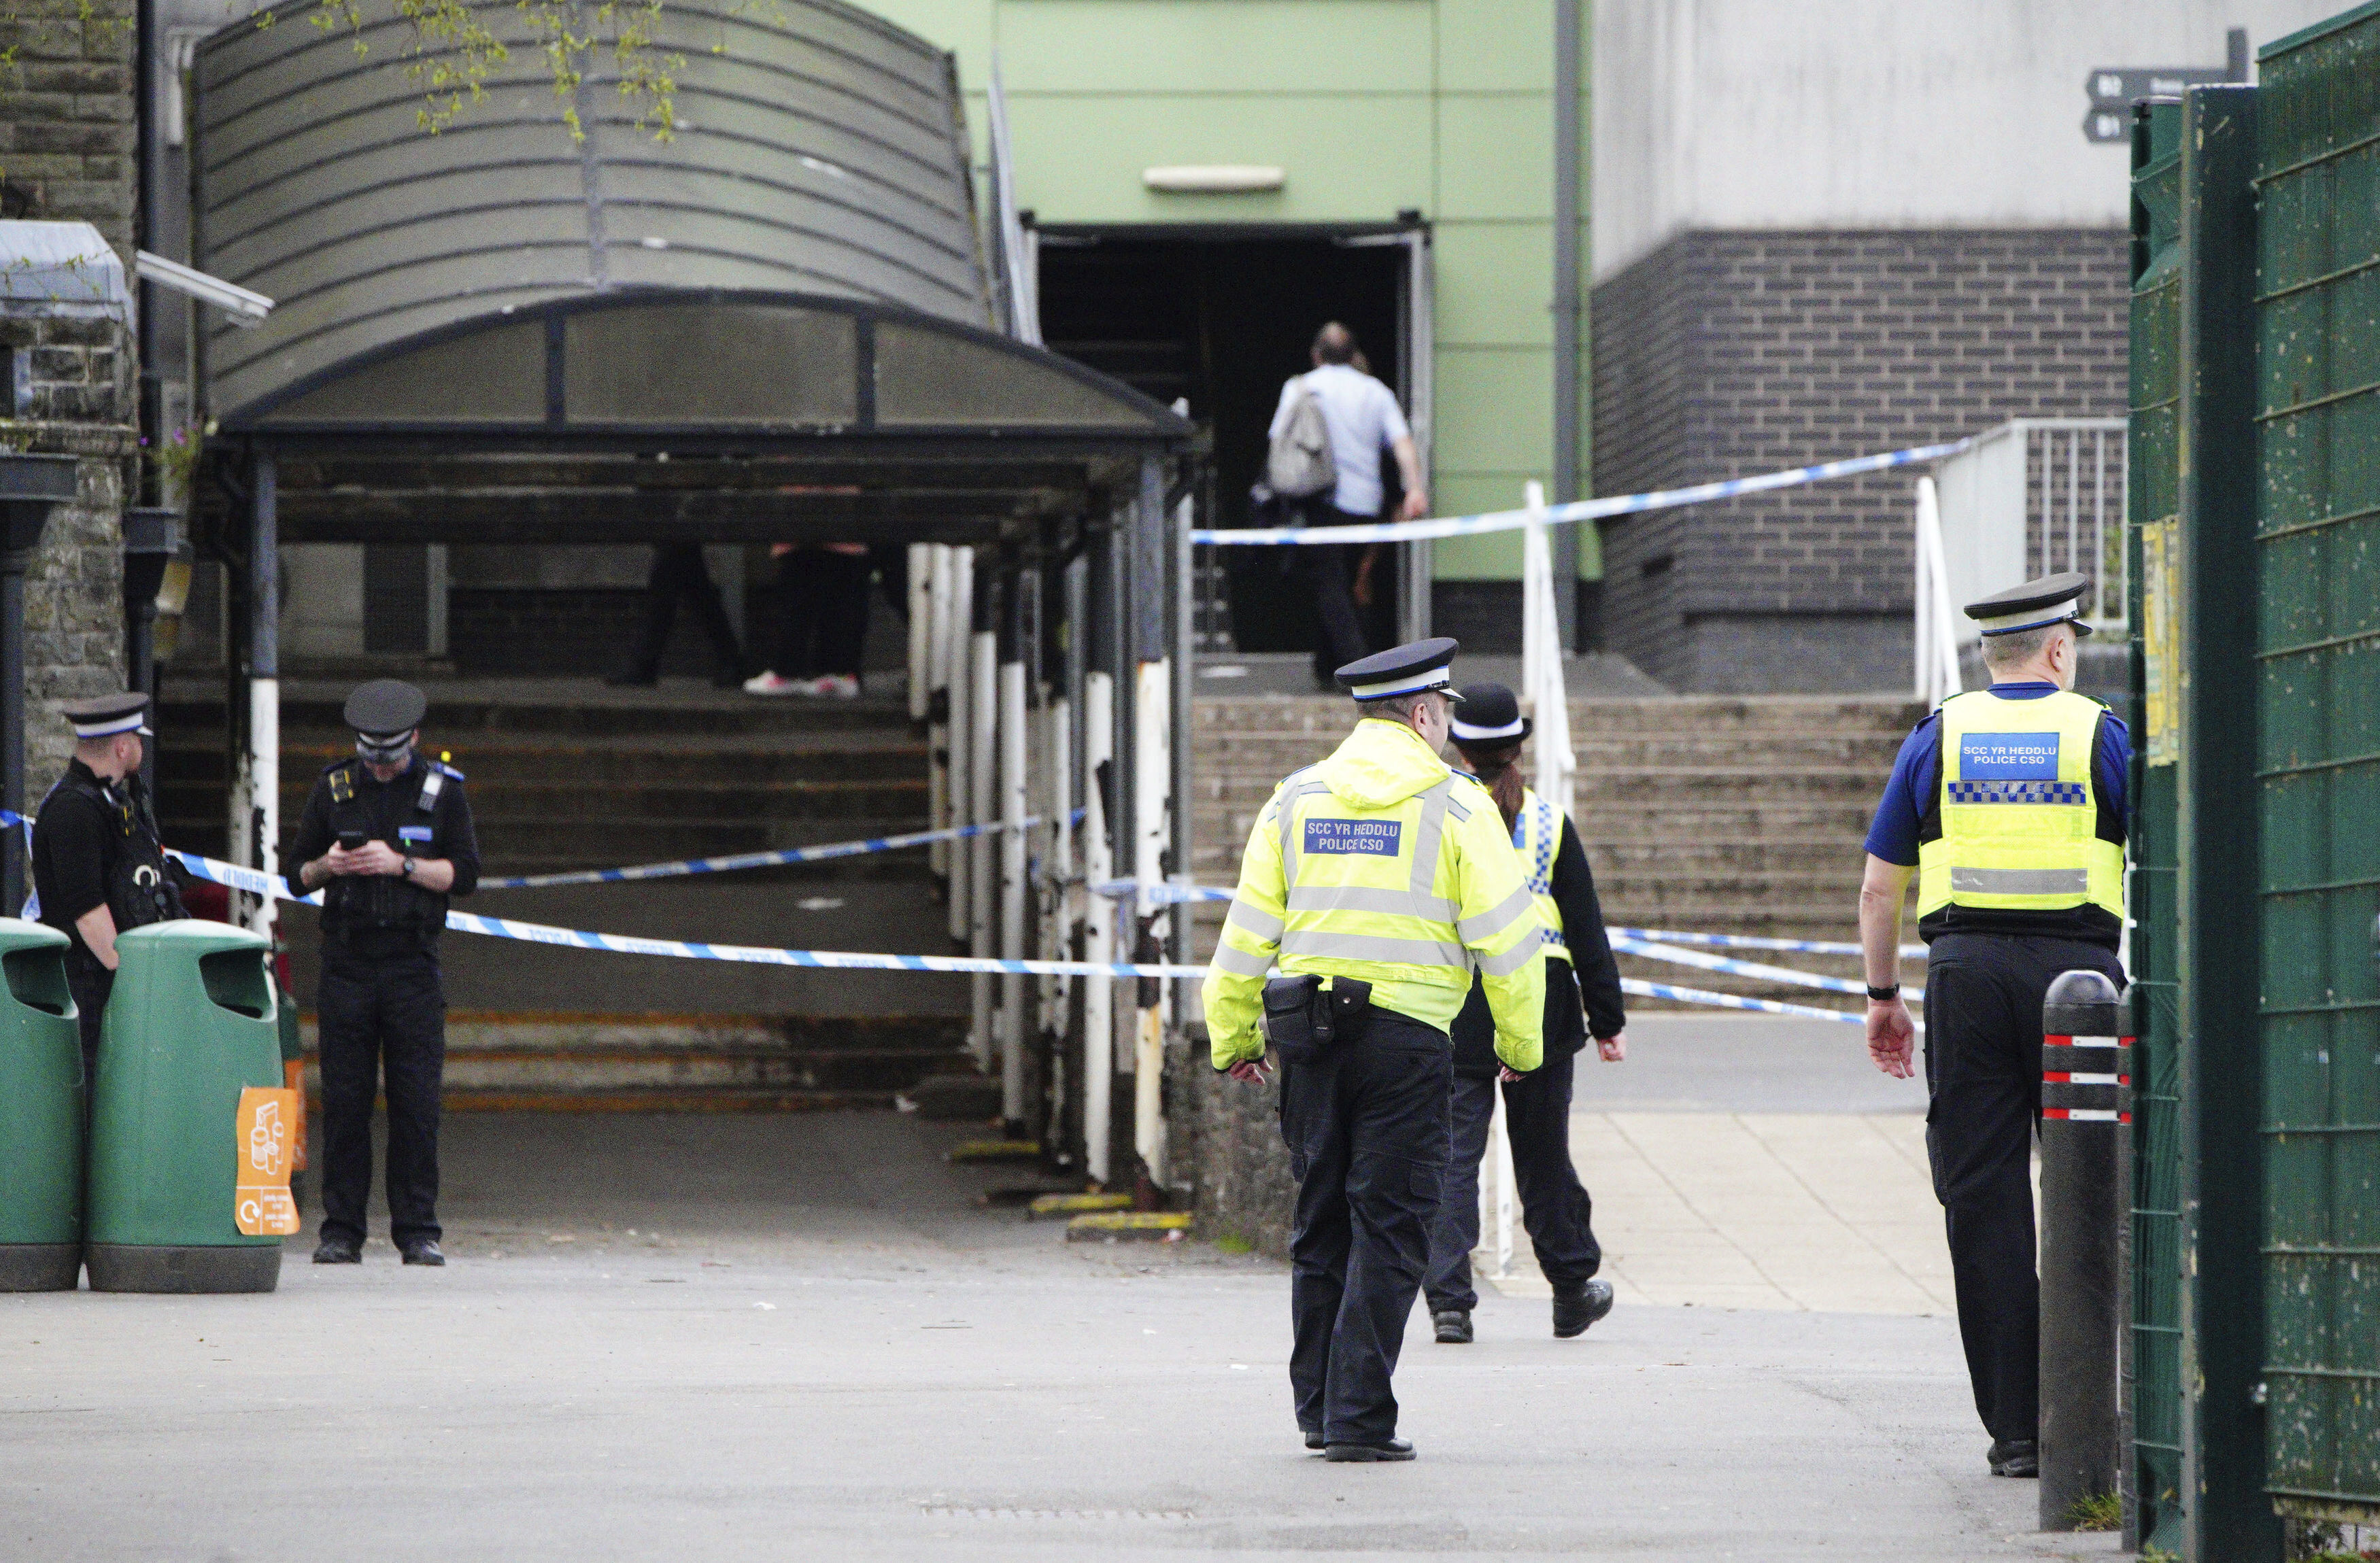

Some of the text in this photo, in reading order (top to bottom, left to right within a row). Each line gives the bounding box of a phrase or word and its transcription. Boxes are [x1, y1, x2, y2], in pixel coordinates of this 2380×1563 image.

[1963, 746, 2056, 755] SCC YR HEDDLU
[1974, 756, 2045, 764] POLICE CSO
[1308, 823, 1398, 836] SCC YR HEDDLU
[1319, 838, 1384, 851] POLICE CSO
